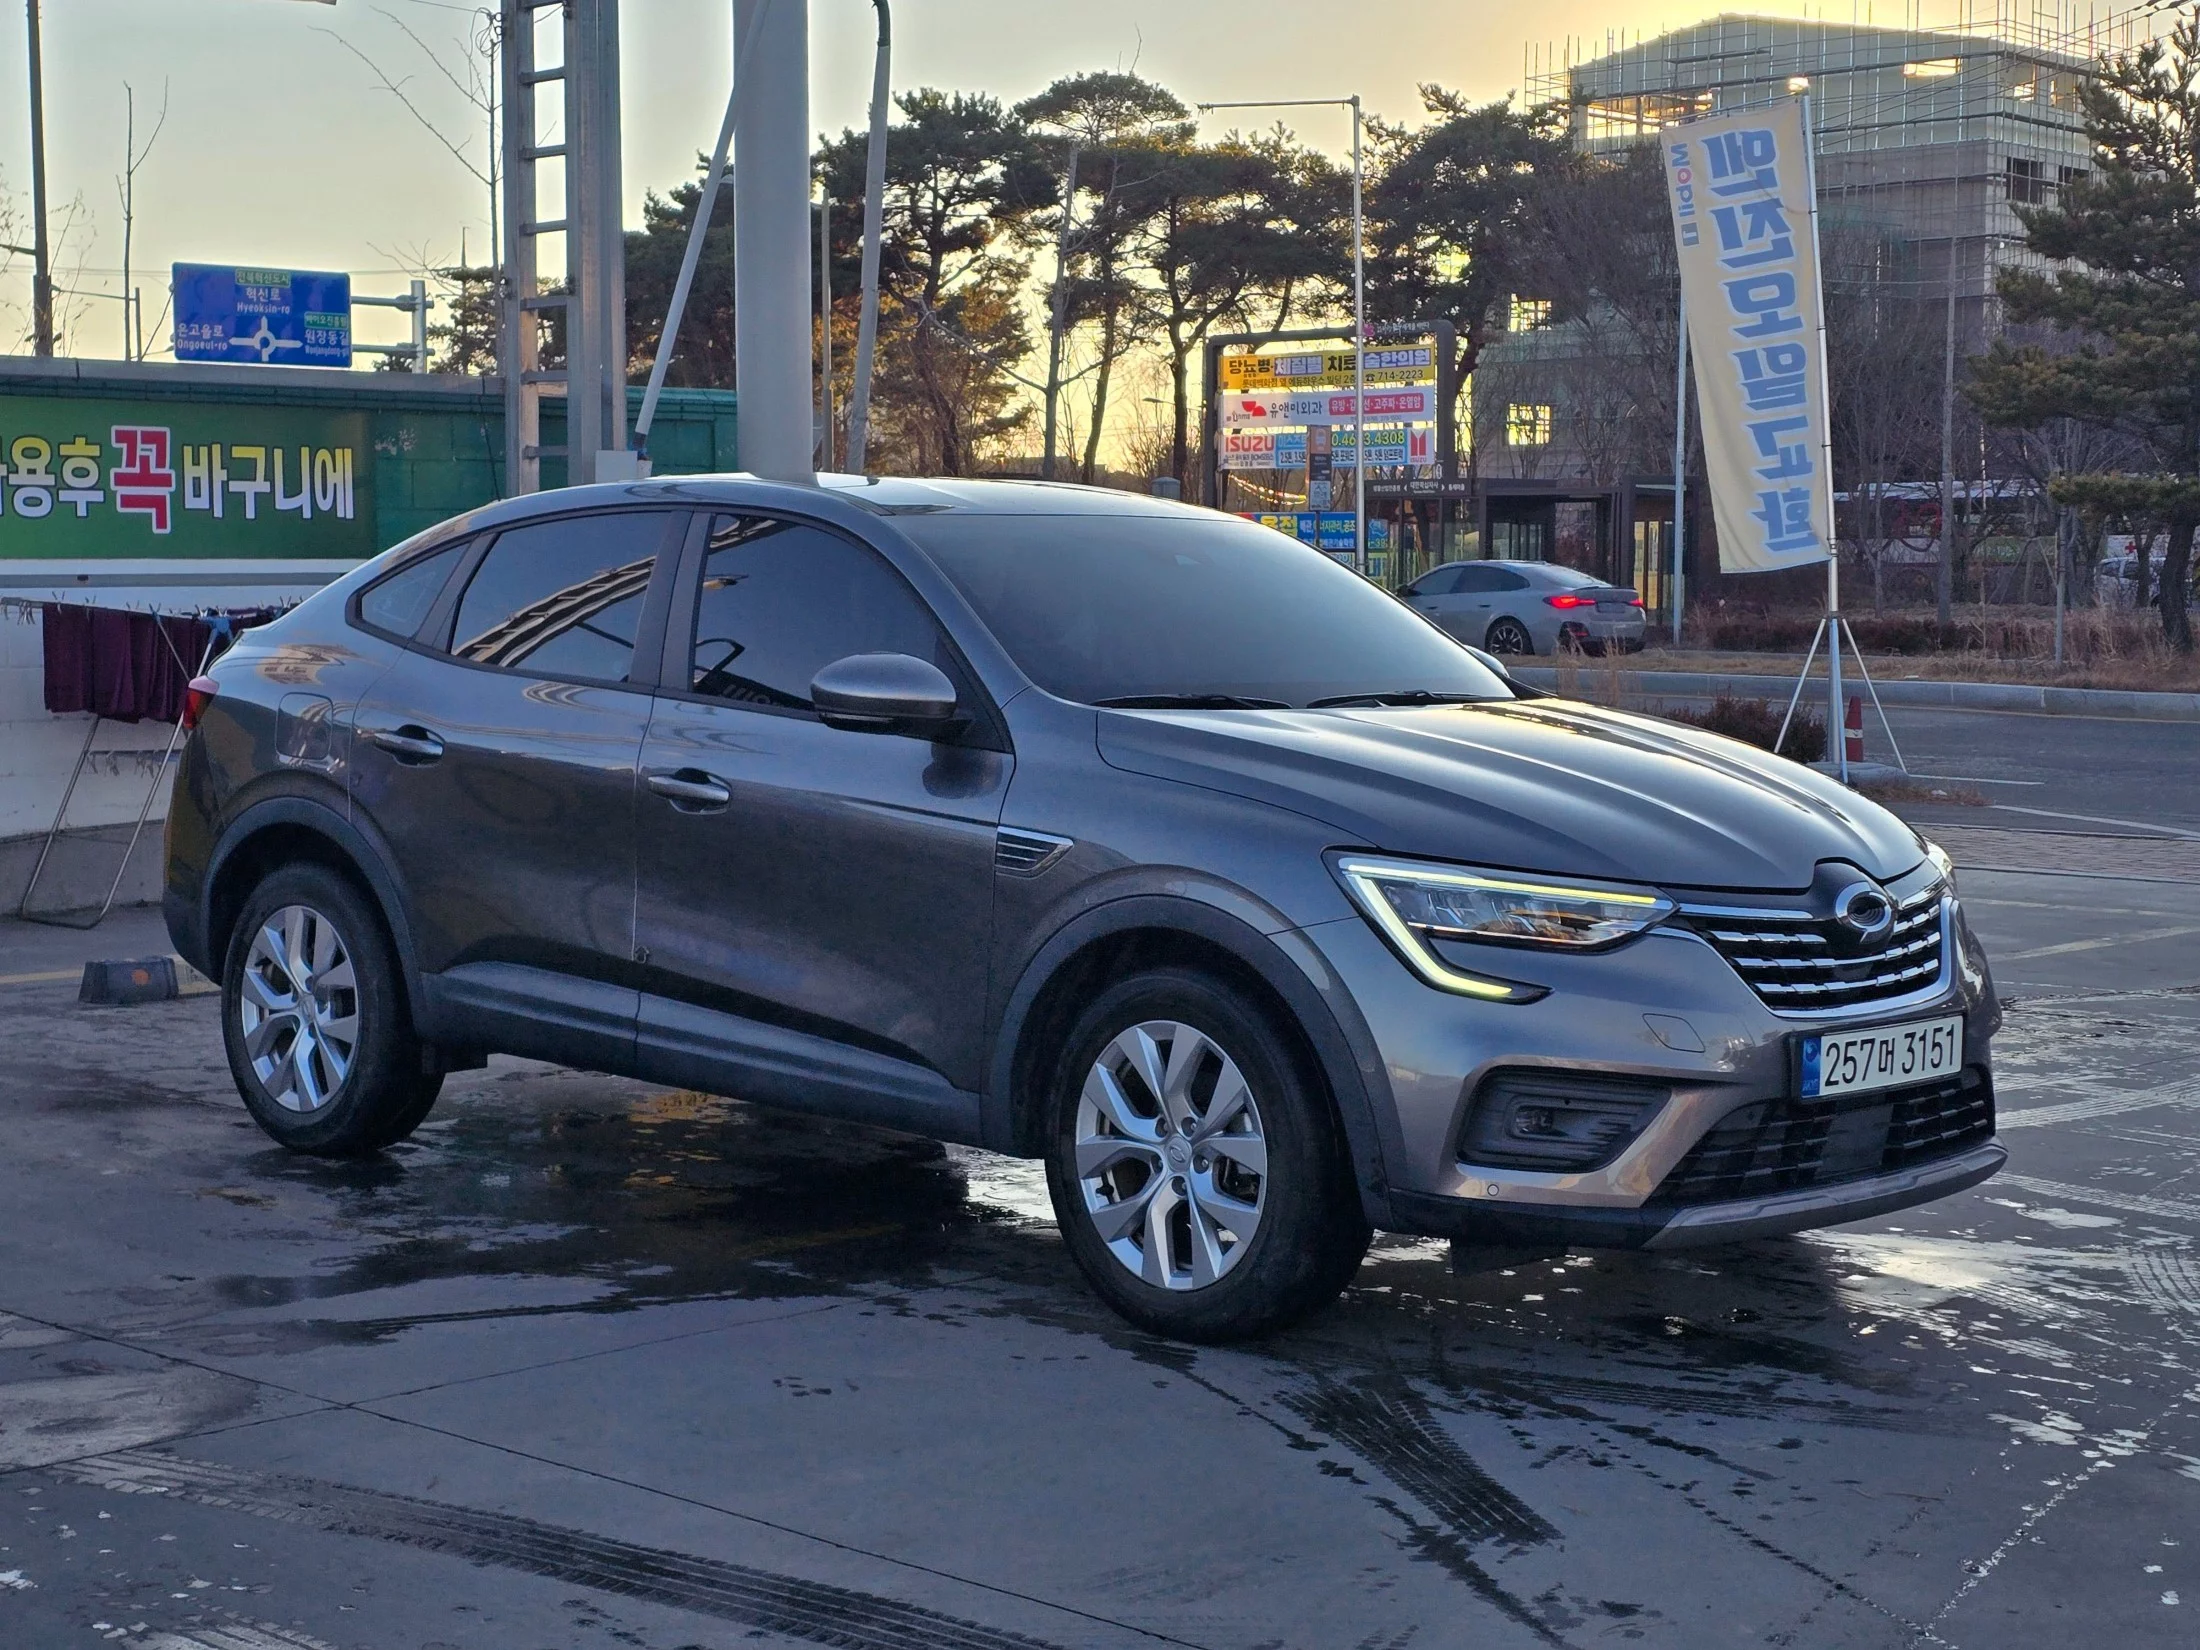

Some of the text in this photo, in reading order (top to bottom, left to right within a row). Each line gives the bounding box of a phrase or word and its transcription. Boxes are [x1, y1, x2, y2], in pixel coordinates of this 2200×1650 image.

[246, 287, 281, 302] 혁신로
[237, 302, 290, 314] Hyeoksin-ro
[177, 323, 224, 339] 온고을로
[305, 329, 349, 344] 원장동길
[177, 339, 227, 351] Ongoeul-ro
[1328, 355, 1357, 371] 치료
[1378, 369, 1424, 380] 714-2223
[1270, 401, 1323, 418] 유앤미외과
[1226, 436, 1275, 452] ISUZU
[0, 425, 356, 534] 용후 꼭 바구니에
[1824, 1023, 1955, 1087] 257머 3151
